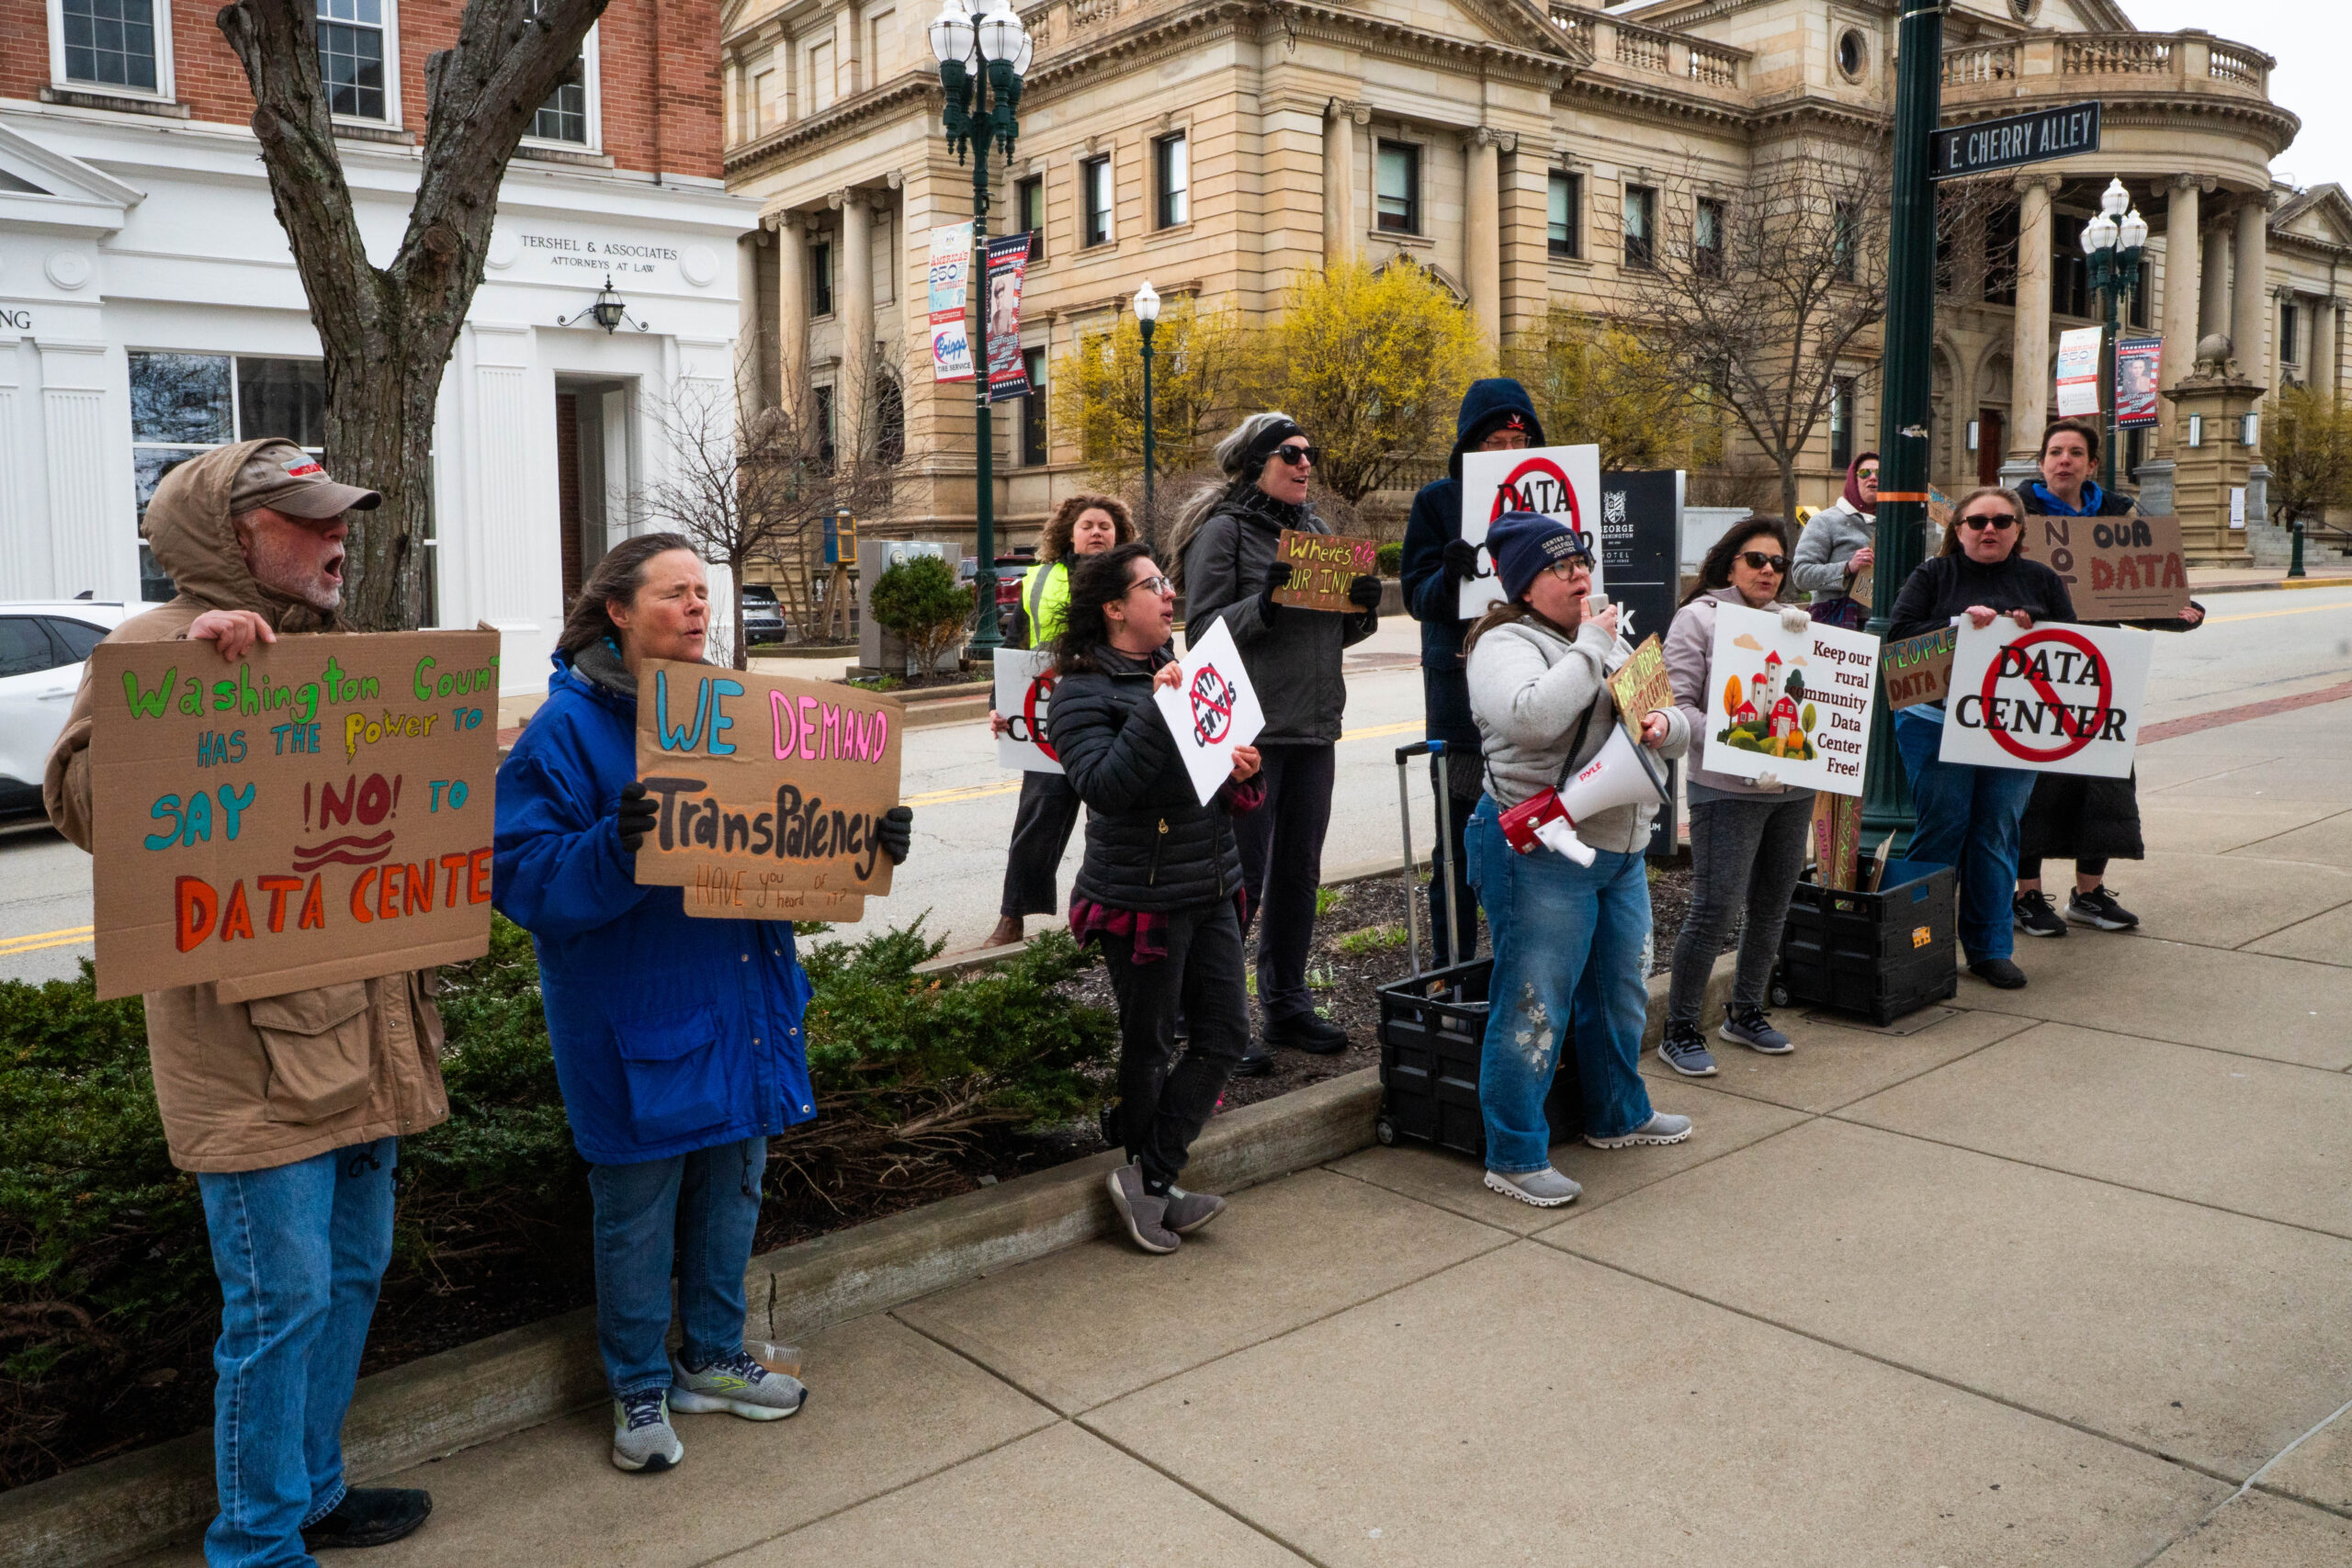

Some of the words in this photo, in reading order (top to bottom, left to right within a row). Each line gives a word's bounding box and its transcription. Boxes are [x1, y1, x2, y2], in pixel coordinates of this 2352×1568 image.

[1950, 137, 1962, 169] E.
[1968, 122, 2033, 165] CHERRY
[2039, 110, 2092, 152] ALLEY
[521, 235, 581, 252] TERSHEL
[587, 242, 596, 253] &
[604, 243, 678, 261] ASSOCIATES
[551, 256, 610, 270] ATTORNEYS
[616, 263, 628, 271] AT
[634, 264, 656, 273] LAW
[930, 264, 957, 284] 250
[936, 336, 967, 360] Briggs
[937, 365, 949, 373] TIRE
[949, 361, 971, 371] SERVICE
[1497, 479, 1573, 518] DATA
[1542, 536, 1564, 548] CENTER
[2093, 519, 2153, 548] OUR
[2090, 552, 2186, 591] DATA
[1813, 640, 1847, 665] Keep
[1849, 651, 1872, 667] our
[1881, 628, 1957, 671] PEOPLE
[1835, 671, 1870, 689] rural
[1996, 645, 2103, 687] DATA
[122, 656, 379, 725] Washington
[1790, 683, 1868, 715] community
[1889, 670, 1937, 702] DATA
[656, 670, 745, 755] WE
[769, 689, 888, 764] DEMAND
[1830, 712, 1861, 733] Data
[1955, 694, 2127, 742] CENTER
[198, 730, 247, 768] HAS
[271, 722, 321, 755] THE
[453, 707, 483, 731] TO
[1817, 732, 1862, 755] Center
[1826, 757, 1860, 777] Free!
[144, 782, 256, 851] SAY
[429, 780, 469, 813] TO
[695, 863, 747, 908] HAVE
[175, 872, 325, 953] DATA
